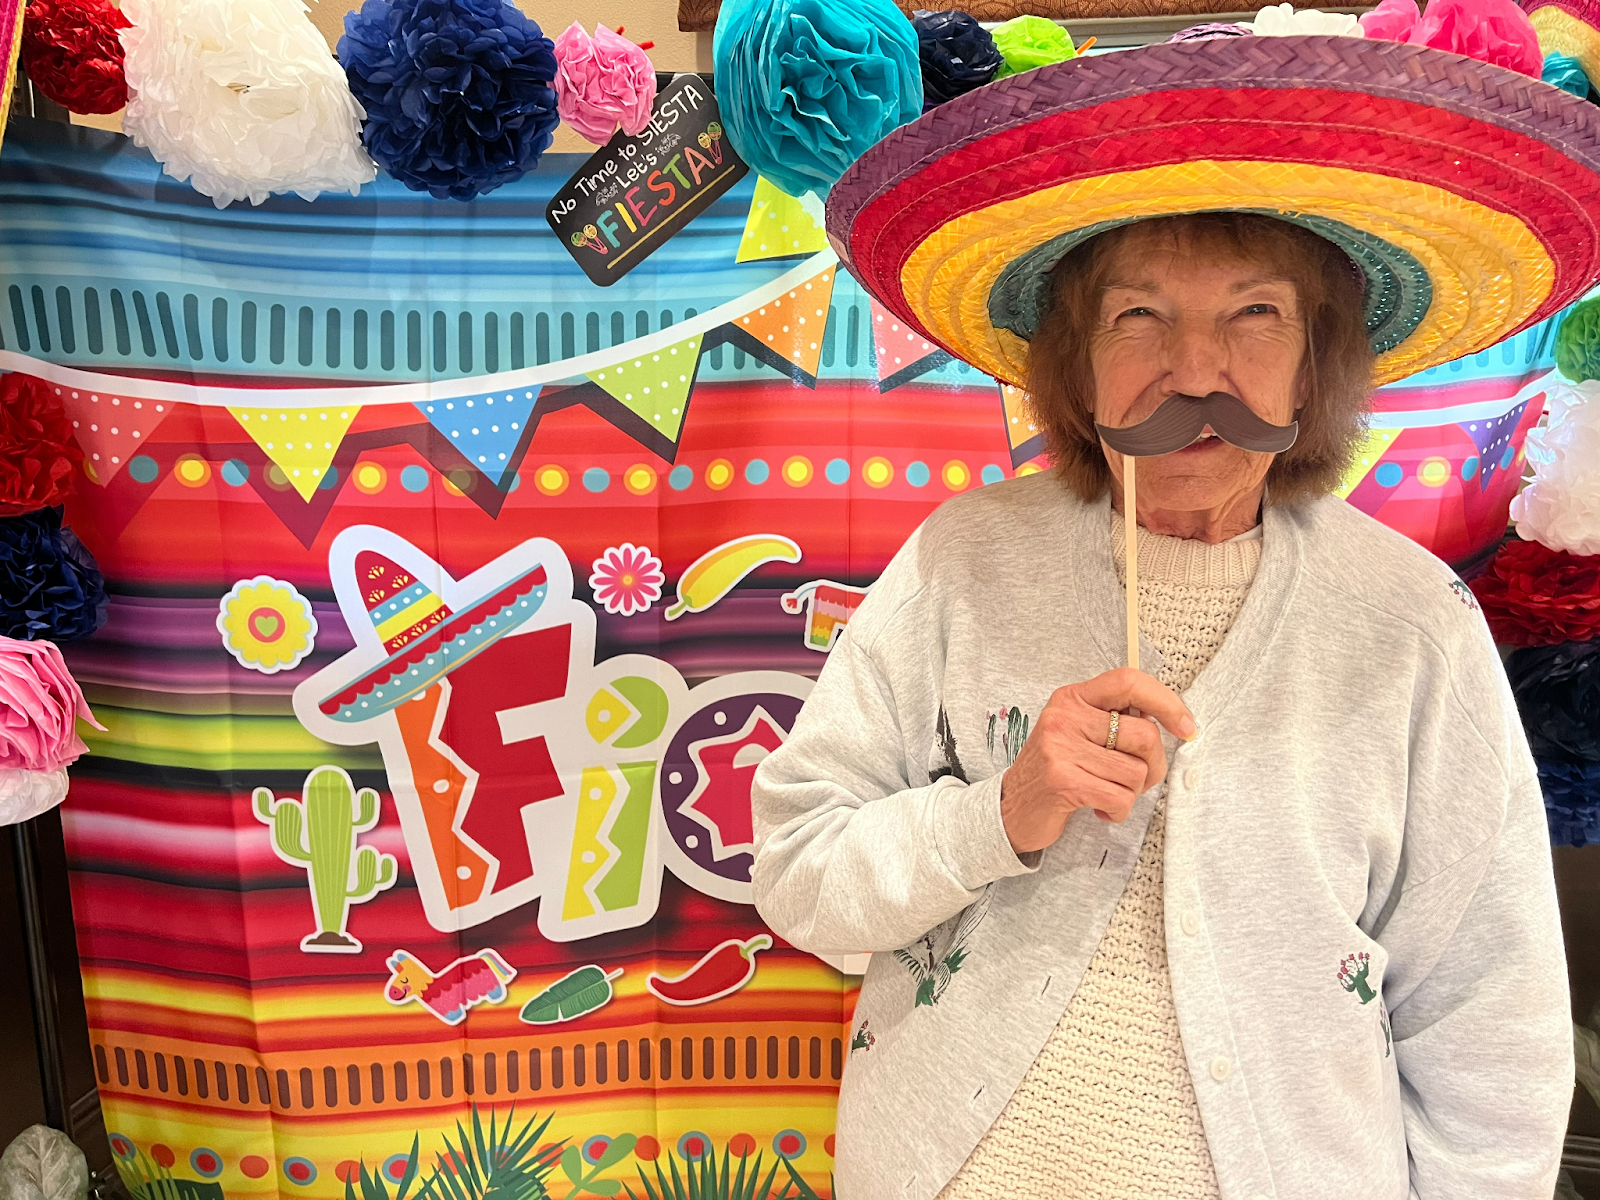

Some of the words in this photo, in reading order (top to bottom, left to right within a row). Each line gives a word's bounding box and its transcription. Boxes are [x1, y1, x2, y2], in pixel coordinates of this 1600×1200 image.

[551, 198, 577, 224] No
[574, 159, 618, 197] Time
[618, 144, 638, 162] to
[636, 84, 704, 146] SIESTA
[596, 147, 716, 248] FIESTA
[614, 153, 658, 189] Let's
